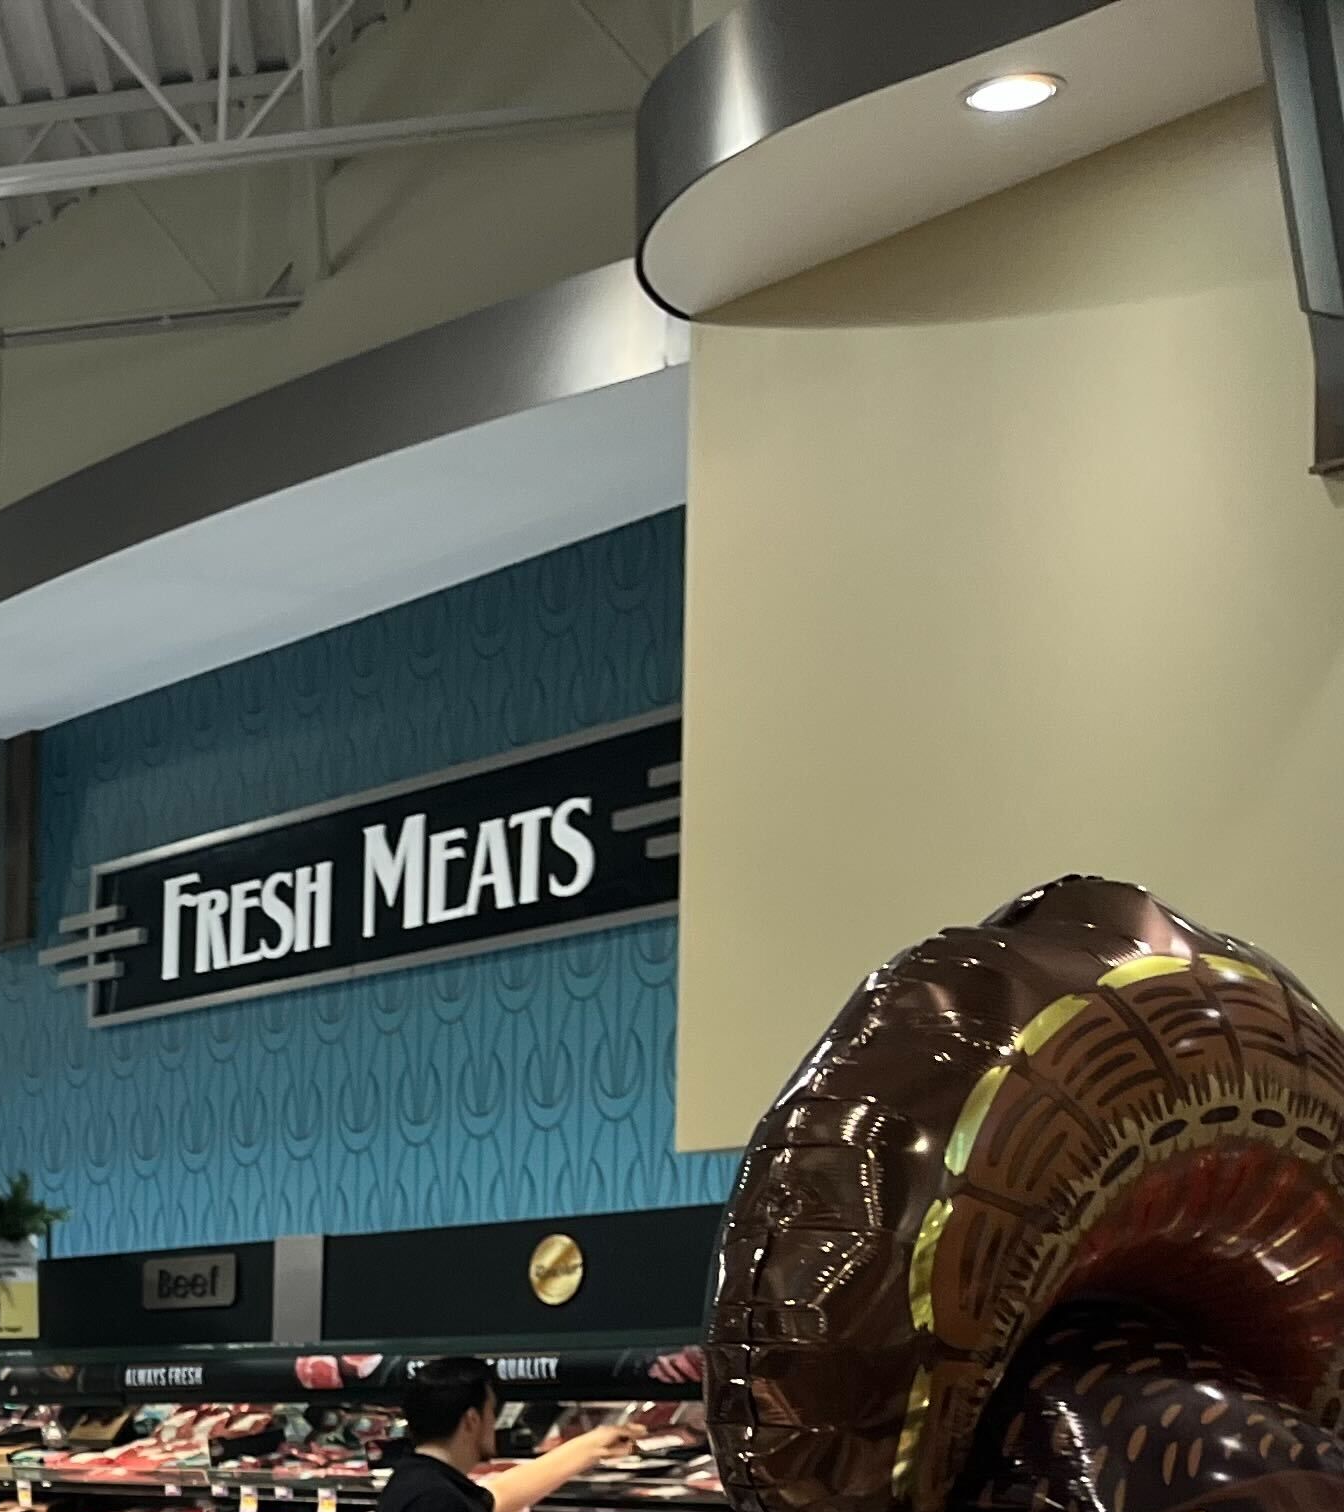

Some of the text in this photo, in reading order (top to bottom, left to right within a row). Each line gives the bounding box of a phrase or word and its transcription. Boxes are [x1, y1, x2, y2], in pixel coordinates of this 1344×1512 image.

[162, 797, 595, 980] FRESH MEATS
[156, 1264, 221, 1300] Beef
[125, 1365, 204, 1387] ALWAYS FRESH
[496, 1356, 559, 1381] QUALITY
